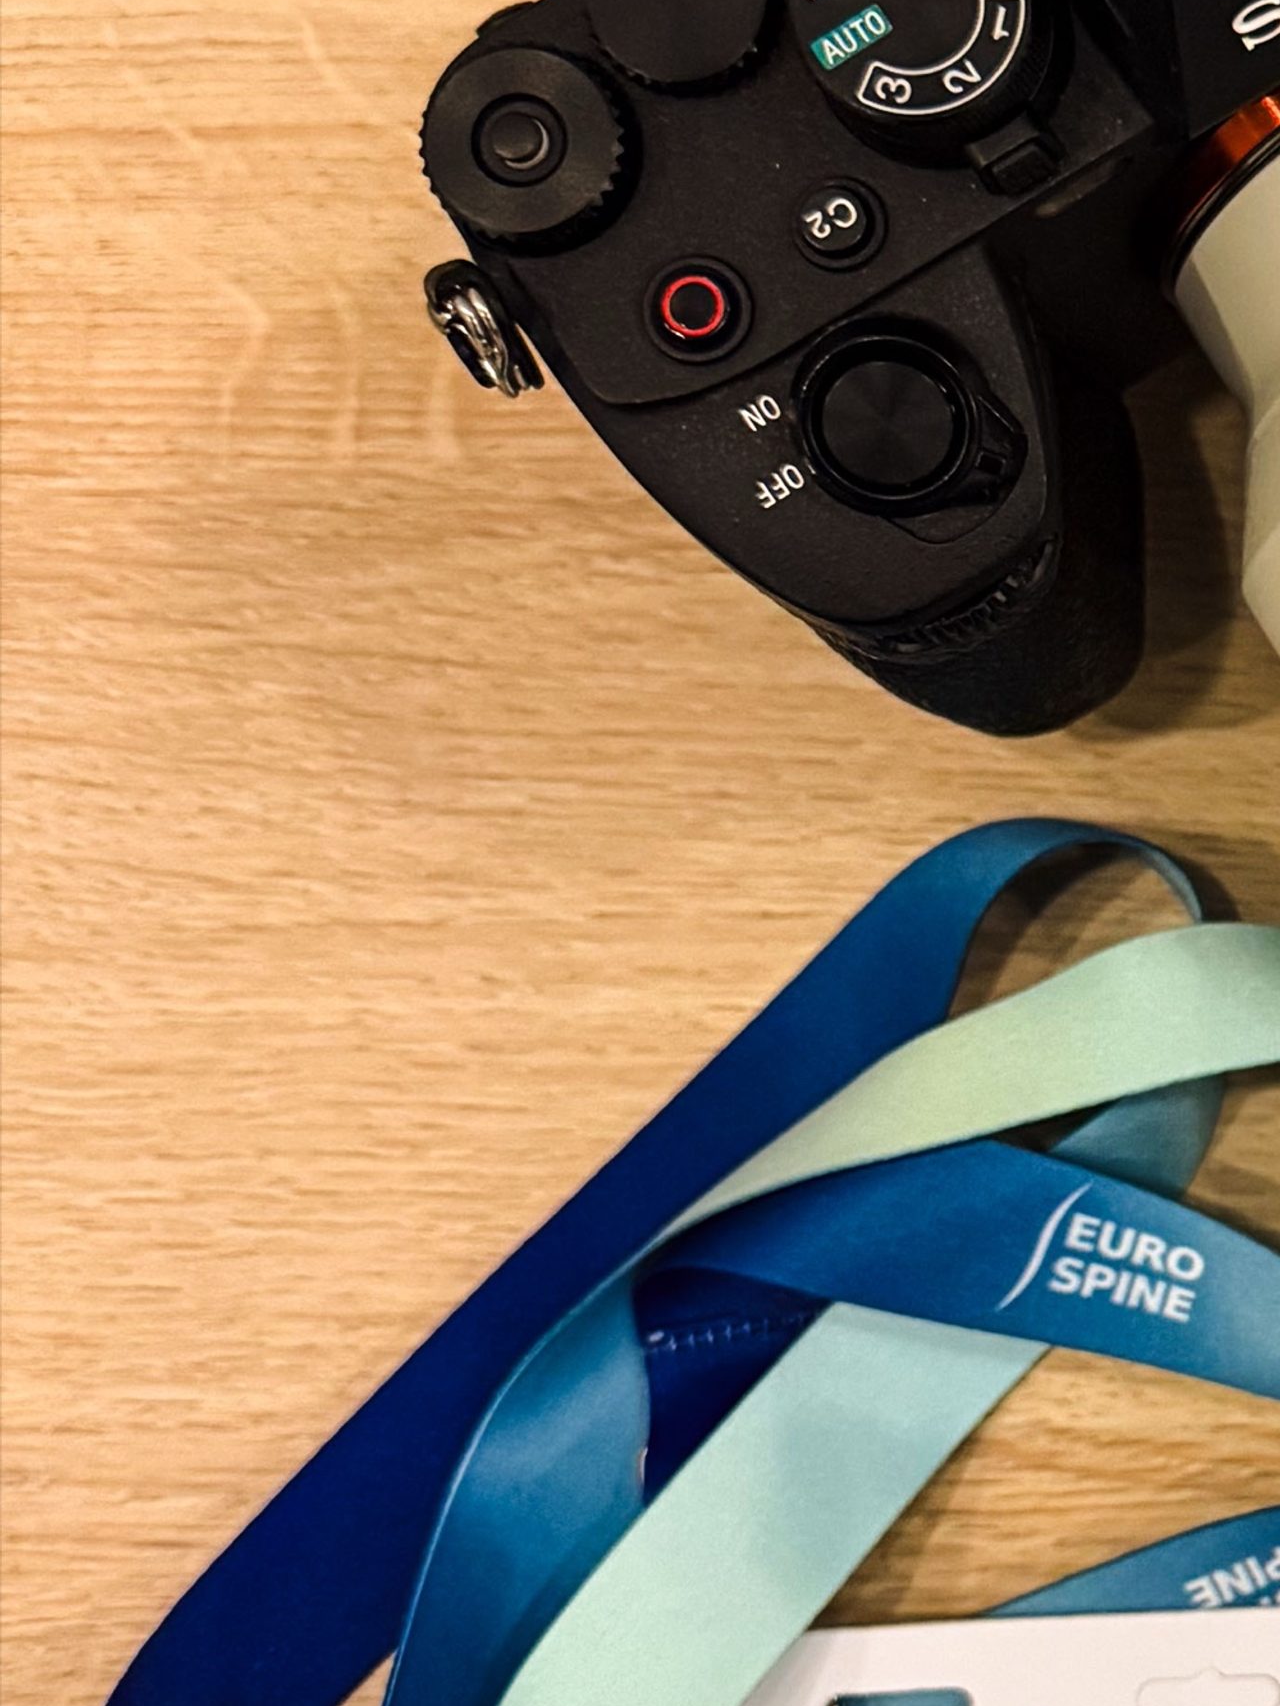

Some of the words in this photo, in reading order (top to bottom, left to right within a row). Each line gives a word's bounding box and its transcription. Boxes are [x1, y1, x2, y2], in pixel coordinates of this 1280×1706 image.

[819, 9, 887, 66] AUTO
[803, 197, 858, 240] C2
[738, 394, 781, 433] ON
[756, 463, 805, 510] OFF
[1064, 1212, 1206, 1281] EURO
[1047, 1255, 1197, 1324] SPINE
